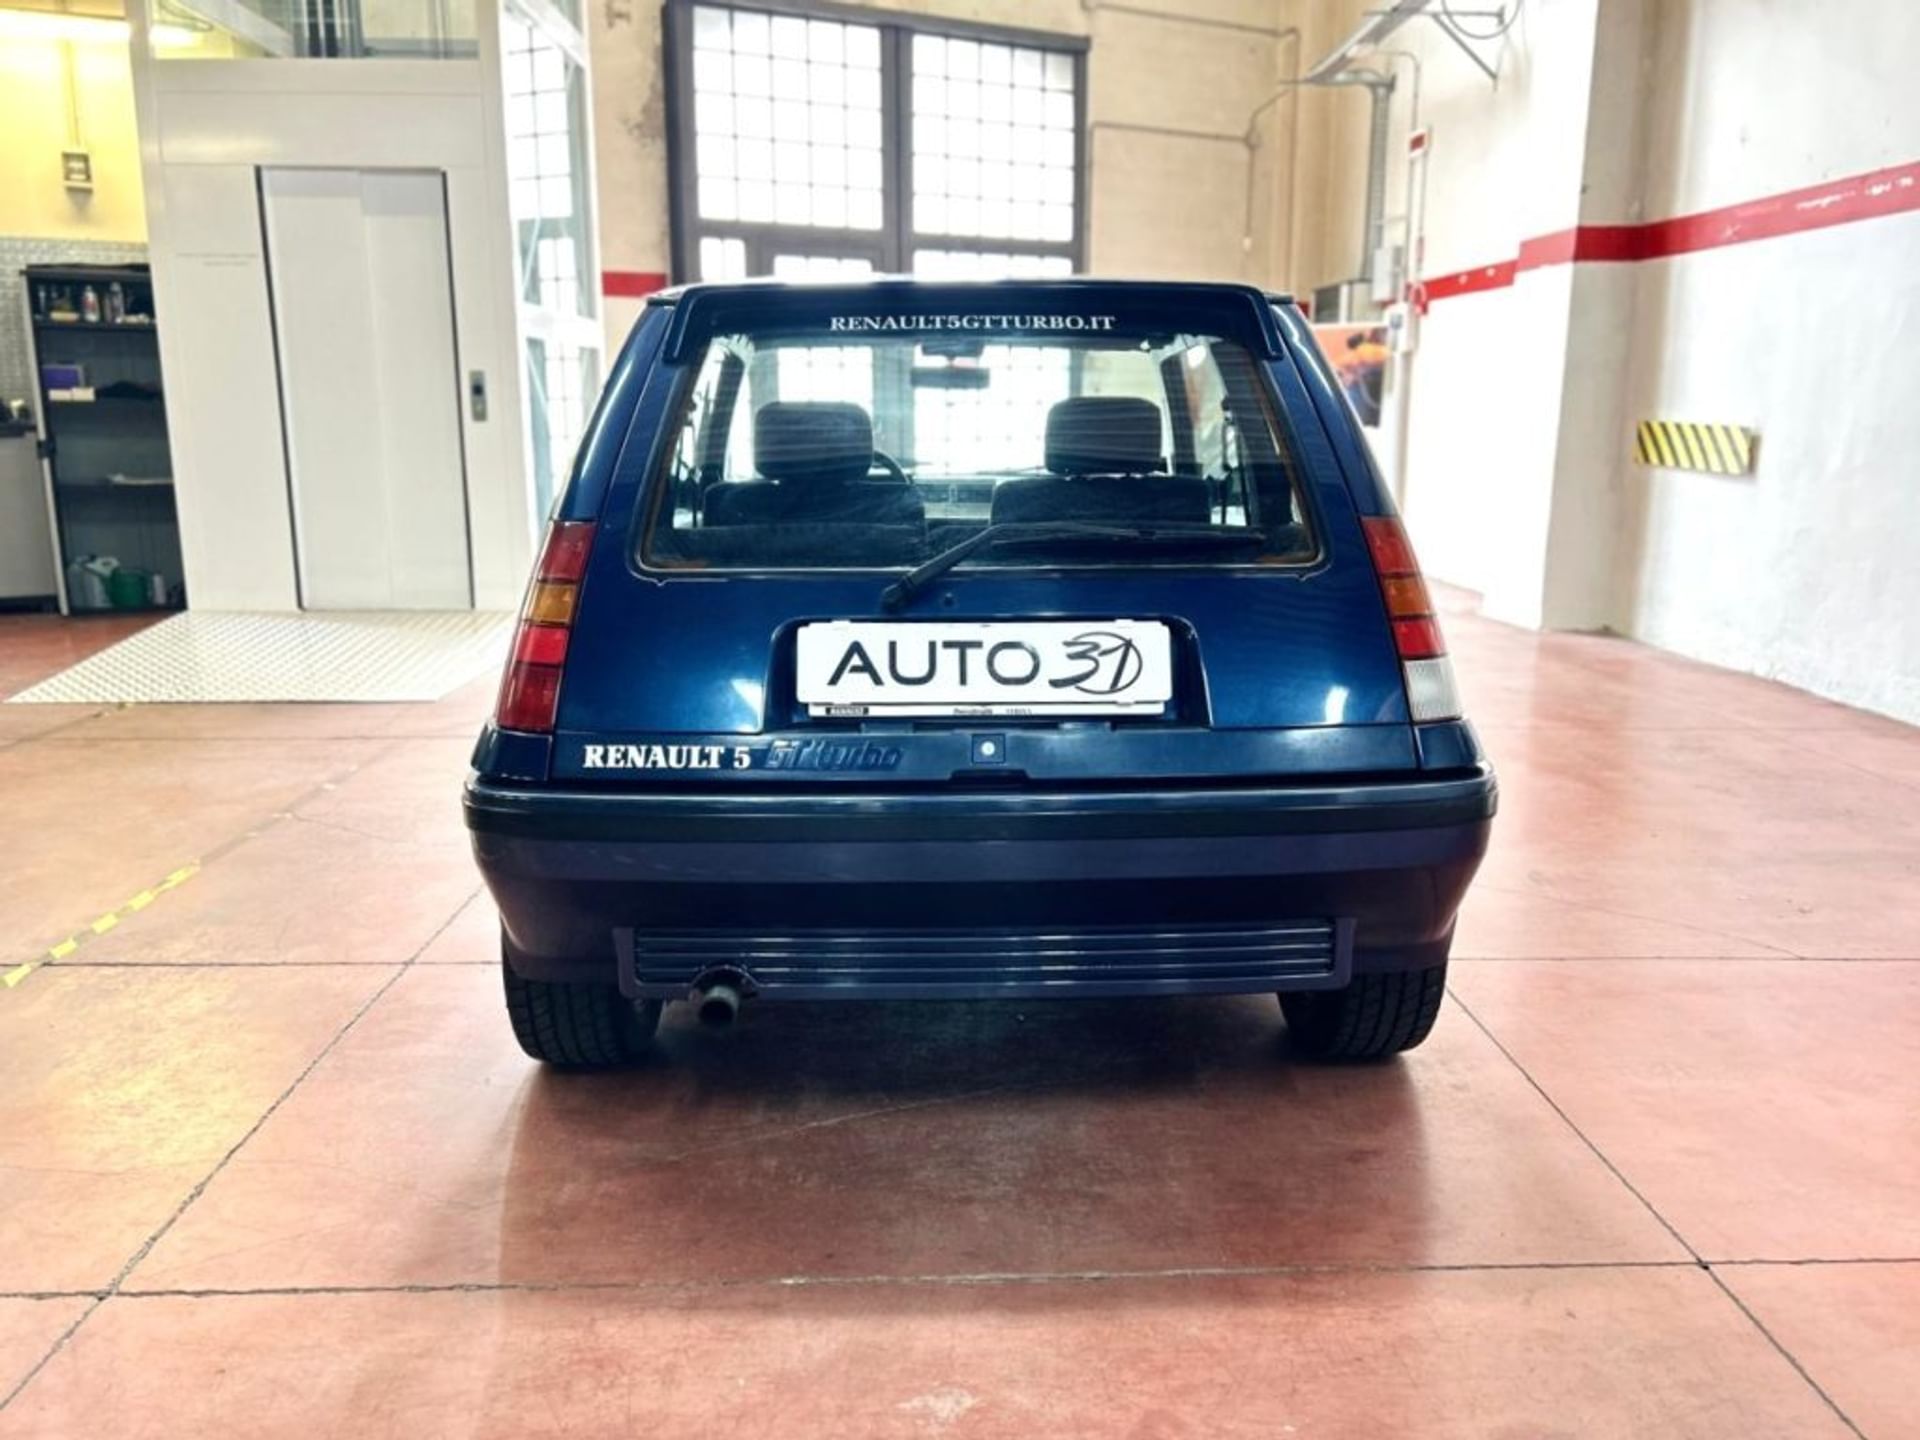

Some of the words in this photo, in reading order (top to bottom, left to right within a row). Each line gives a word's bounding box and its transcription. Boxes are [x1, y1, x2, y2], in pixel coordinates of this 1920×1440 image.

[831, 315, 1115, 331] RENAULT5GTTURBO.IT
[827, 640, 1040, 686] AUTO
[583, 744, 725, 769] RENAULT
[733, 745, 751, 769] 5
